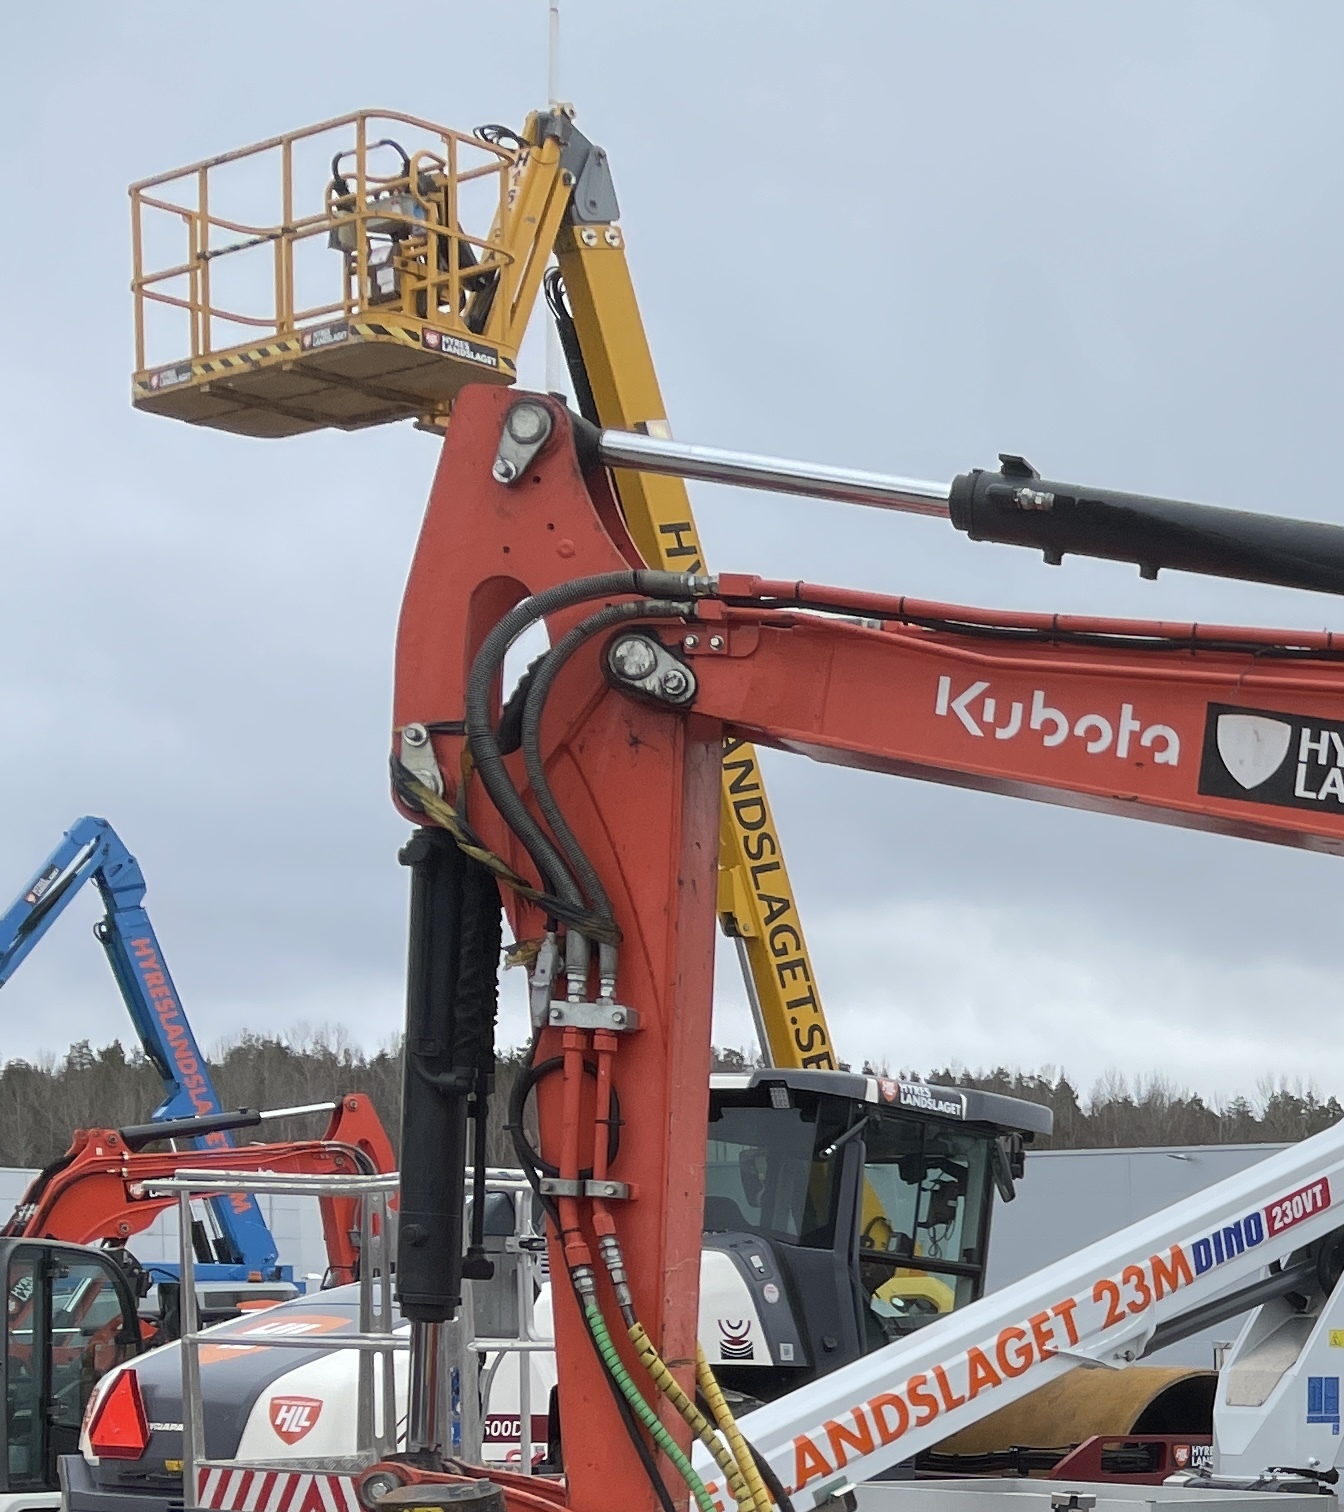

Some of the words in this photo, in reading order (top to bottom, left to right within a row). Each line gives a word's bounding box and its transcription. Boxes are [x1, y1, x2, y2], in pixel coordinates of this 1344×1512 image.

[935, 676, 1181, 767] Kubota
[900, 1093, 961, 1116] LANDSLAGET
[1093, 1243, 1194, 1331] 23M
[1192, 1211, 1264, 1276] DINO
[1272, 1184, 1324, 1231] 230VT
